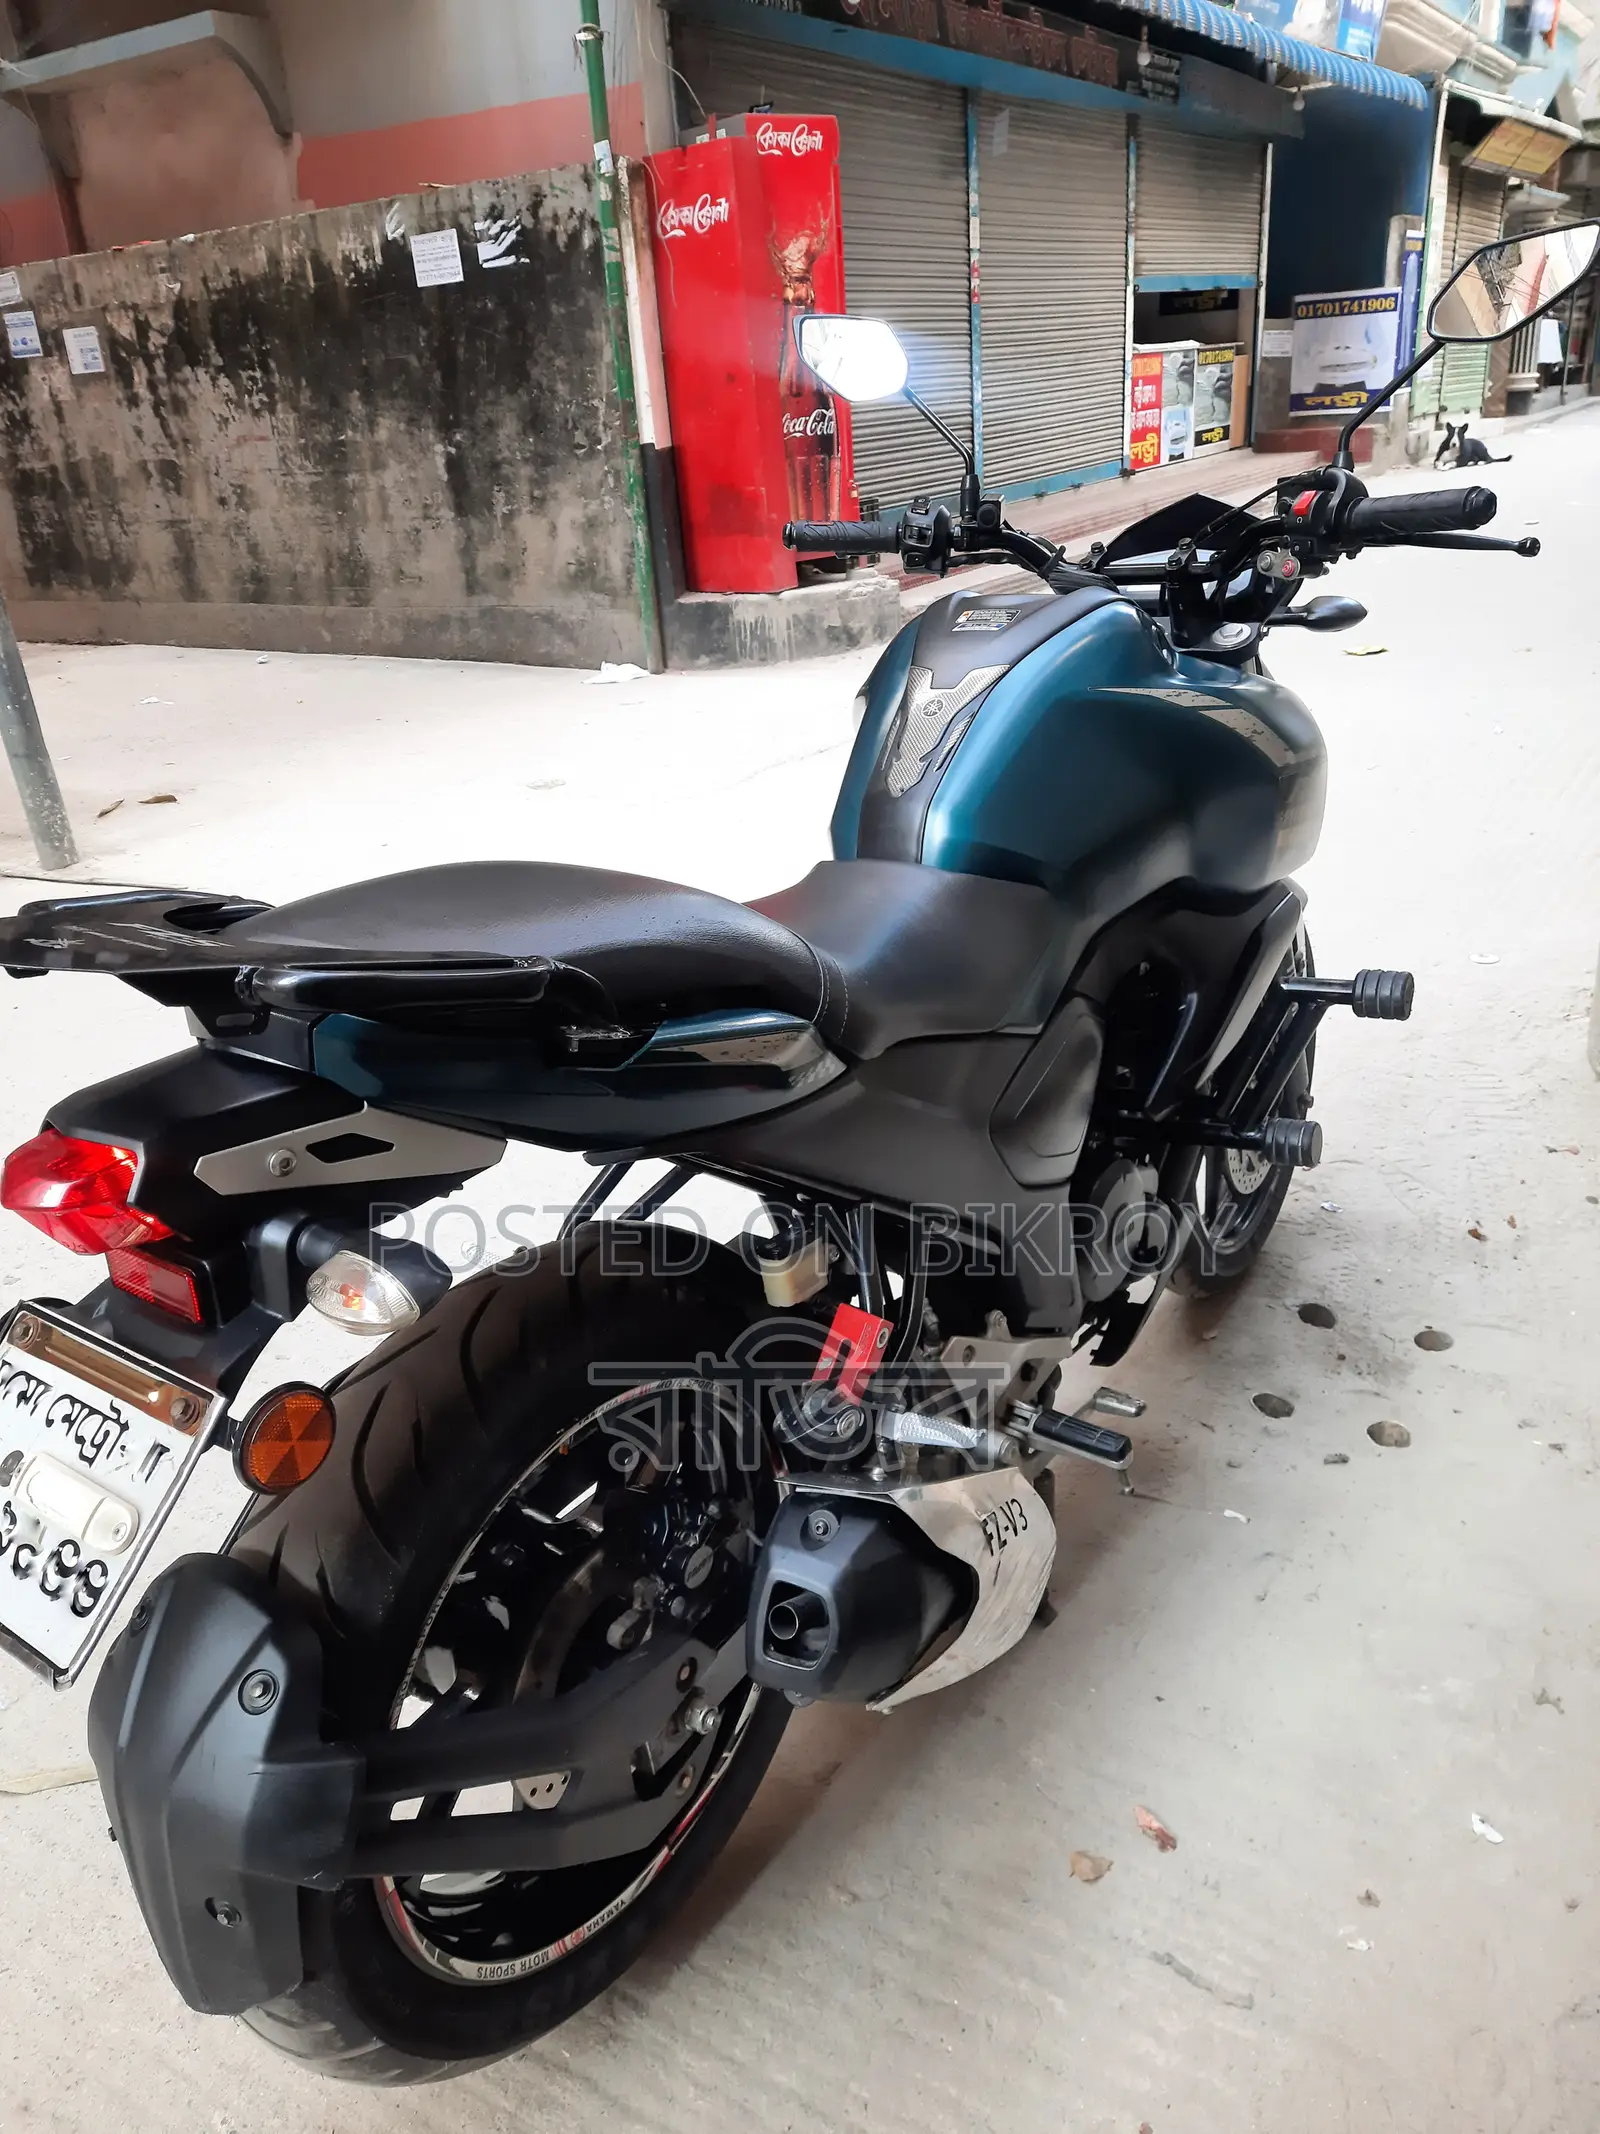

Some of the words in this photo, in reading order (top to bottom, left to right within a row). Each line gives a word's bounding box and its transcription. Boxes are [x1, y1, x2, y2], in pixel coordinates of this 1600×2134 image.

[1297, 297, 1396, 317] 01701741906
[980, 1498, 1028, 1557] FZ-V3
[585, 1899, 627, 1934] YAMAHA
[475, 1963, 517, 1980] SPORTS
[519, 1950, 551, 1973] MOTR
